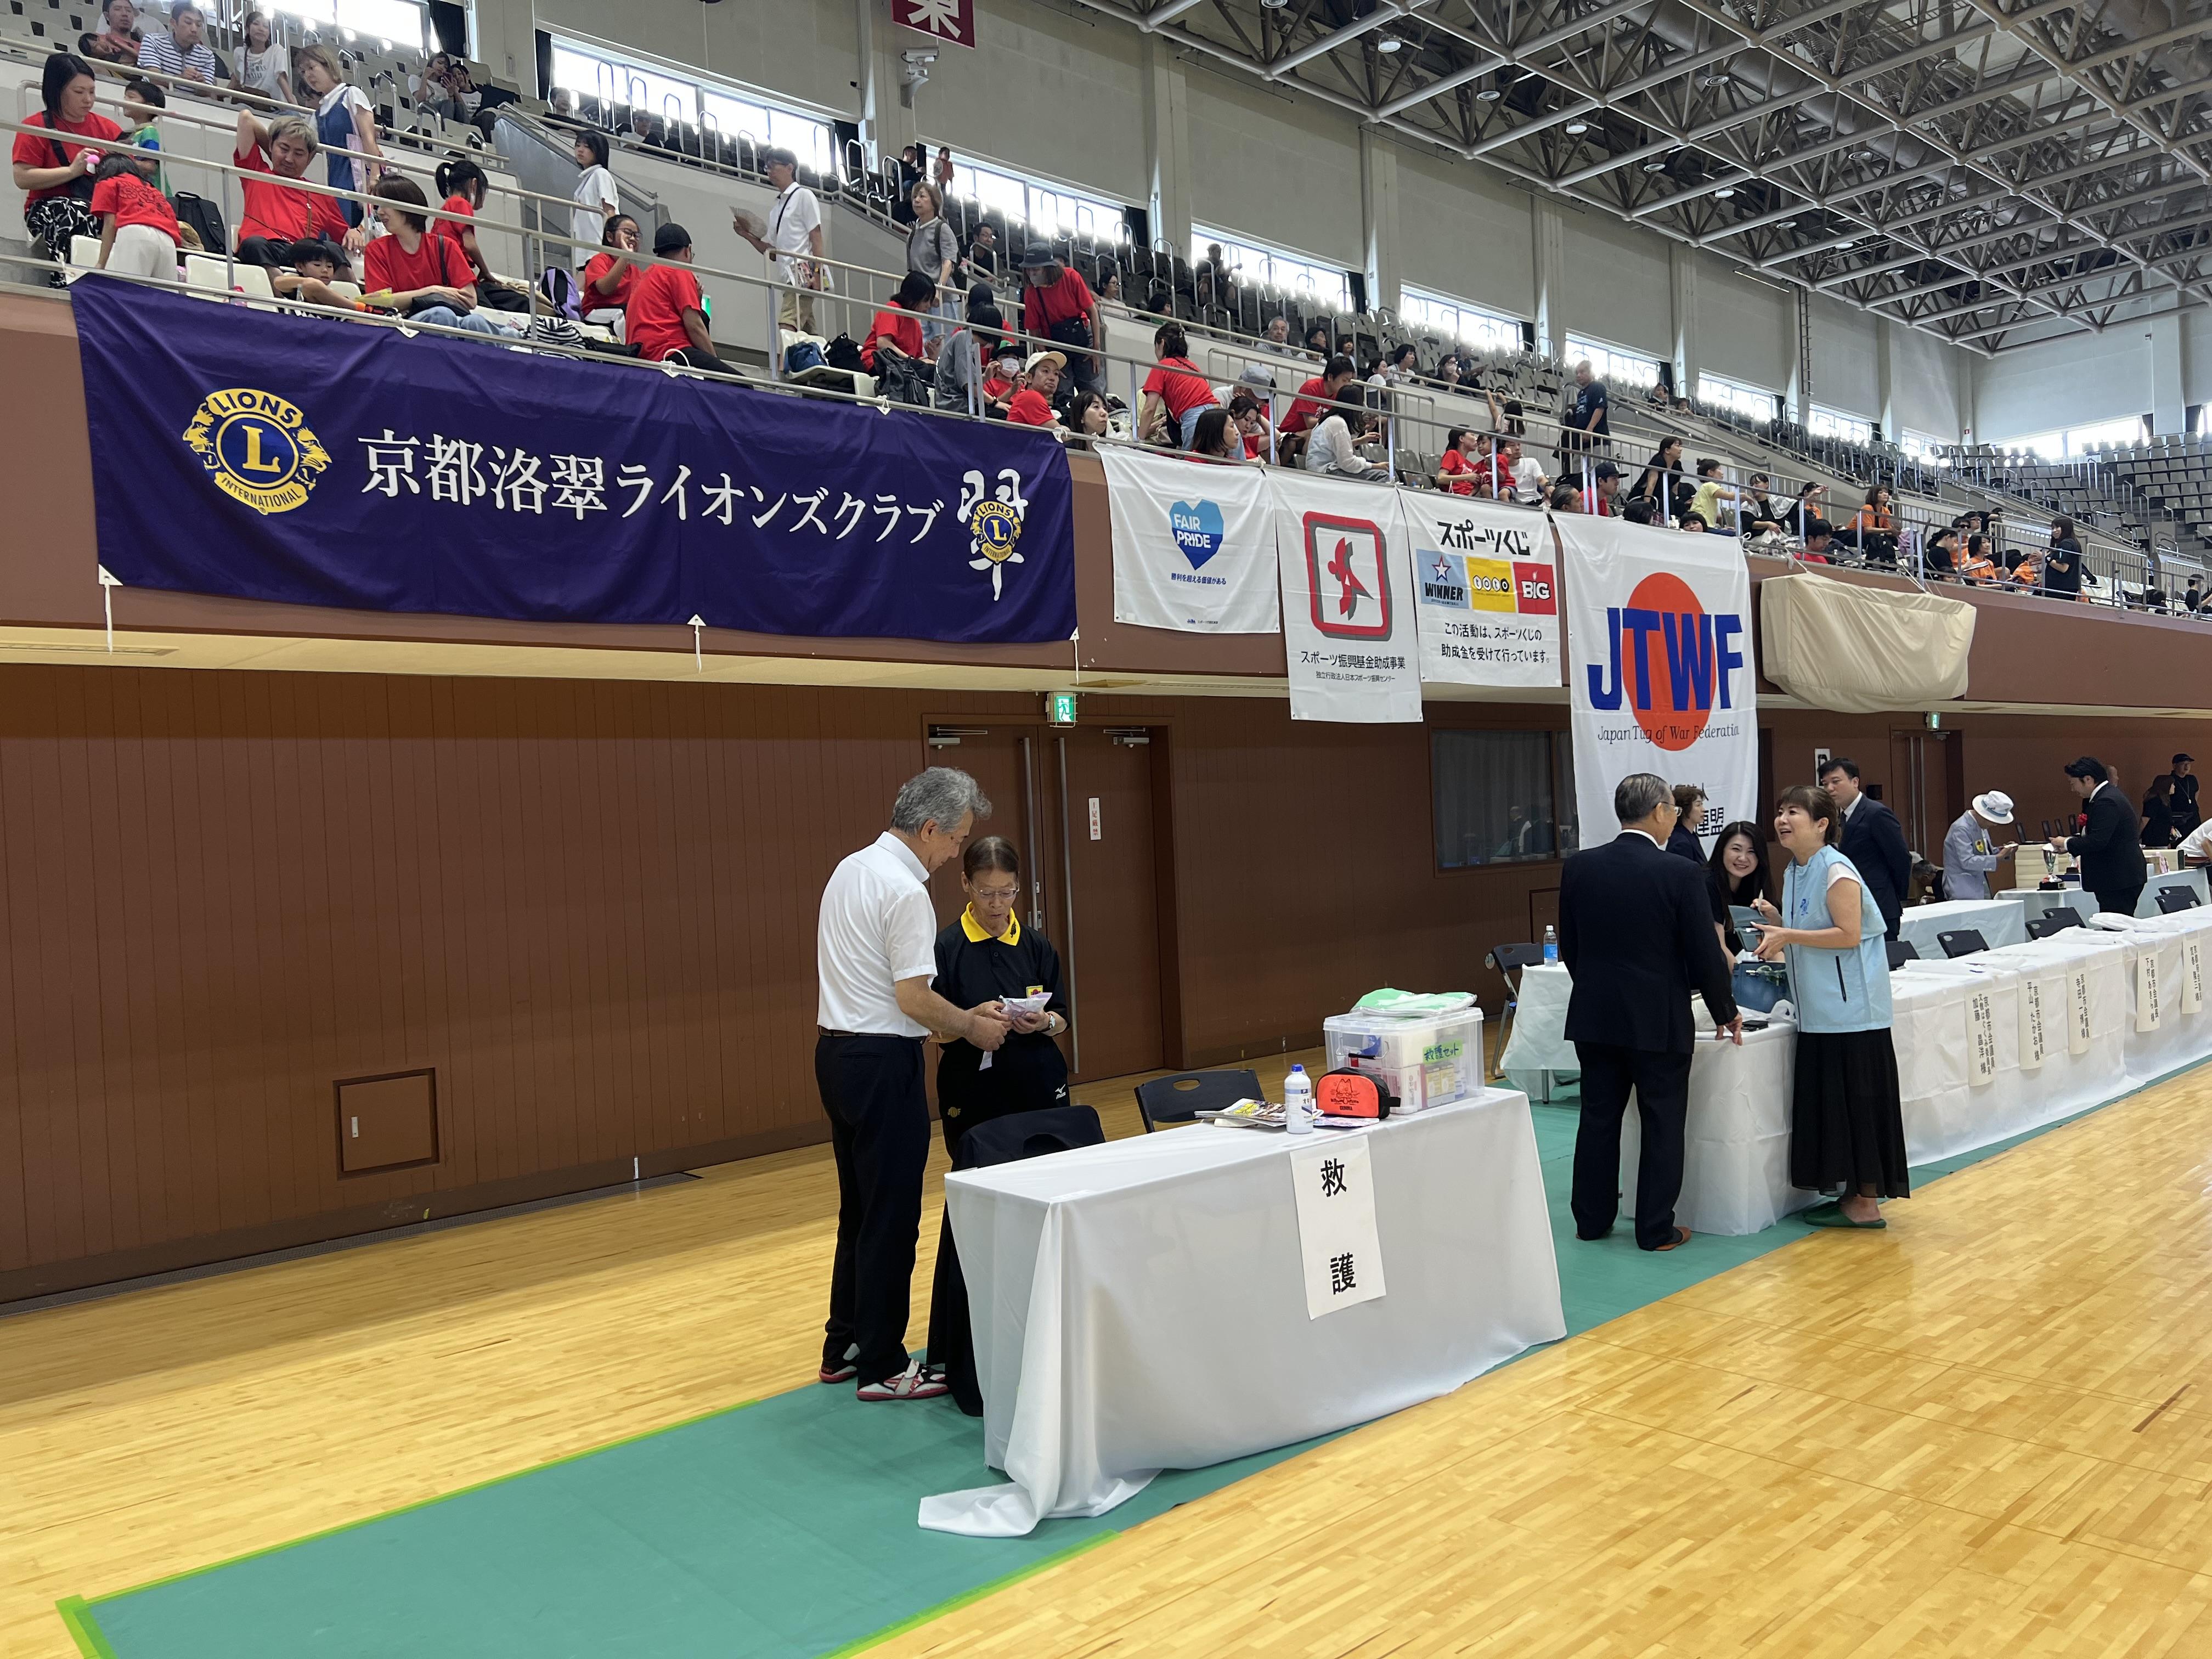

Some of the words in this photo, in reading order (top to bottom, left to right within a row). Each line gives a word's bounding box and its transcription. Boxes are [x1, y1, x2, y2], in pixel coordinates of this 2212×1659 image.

[212, 392, 297, 424] LIONS
[241, 425, 281, 473] L
[222, 477, 302, 508] INTERNATIONAL
[358, 428, 945, 544] 京都洛翠ライオンズクラブ
[979, 503, 1011, 516] LIONS
[991, 520, 1007, 541] L
[1173, 513, 1201, 531] FAIR
[1176, 530, 1212, 549] PRIDE
[1437, 518, 1531, 556] スポーツくじ
[984, 545, 1011, 558] INTERNATIONAL
[1171, 573, 1227, 585] 勝利を超える価値がある
[1473, 575, 1510, 592] toto
[1425, 582, 1464, 601] WINNER
[1521, 580, 1551, 600] BIG
[1444, 622, 1542, 641] この活動は、スポーツくじの
[1301, 651, 1406, 670] スポーツ振興基金助成事業
[1441, 644, 1550, 664] 助成金を受けて行っています。
[1587, 607, 1744, 712] JTWF
[1316, 670, 1396, 682] 独立行政法人日本スポーツ振興センター
[1598, 726, 1631, 745] Japan
[1632, 726, 1652, 743] Tug
[1656, 725, 1668, 744] of
[1669, 725, 1690, 740] War
[1424, 1042, 1460, 1061] 救護セット
[1320, 1157, 1357, 1295] 救護
